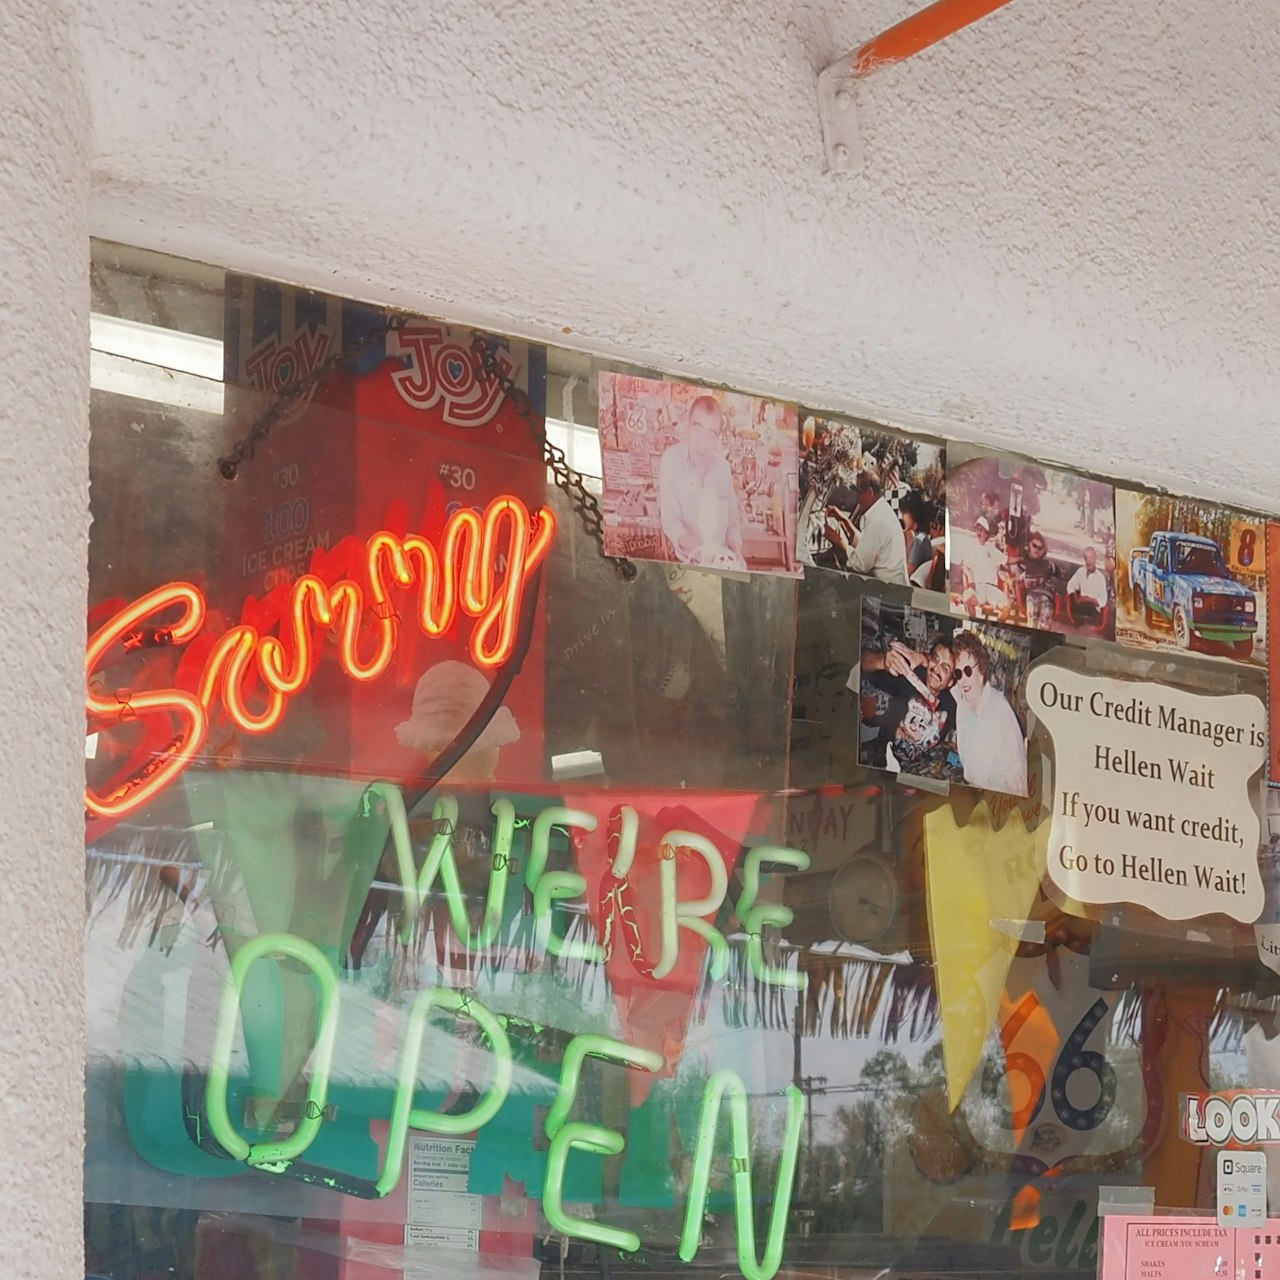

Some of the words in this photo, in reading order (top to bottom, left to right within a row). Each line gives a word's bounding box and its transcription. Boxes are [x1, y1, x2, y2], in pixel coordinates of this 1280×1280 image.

[439, 462, 477, 491] #30
[242, 550, 268, 576] ICE
[271, 531, 331, 566] CREAM
[1238, 528, 1257, 567] 8
[1040, 682, 1084, 713] Our
[1090, 691, 1152, 727] Credit
[1158, 705, 1245, 747] Manager
[1249, 723, 1265, 748] is
[1094, 745, 1162, 780] Hellen
[1168, 758, 1215, 789] Wait
[1062, 791, 1080, 818] If
[1084, 801, 1121, 827] you
[1127, 808, 1176, 834] want
[1181, 817, 1244, 848] credit,
[358, 779, 810, 990] WE'RE
[1059, 845, 1088, 871] Go
[1095, 853, 1115, 876] to
[1121, 854, 1188, 886] Hellen
[1193, 865, 1246, 895] Wait!
[413, 1142, 452, 1153] Nutrition
[413, 1179, 443, 1188] Calories
[1235, 1162, 1262, 1174] Square
[1136, 1229, 1151, 1237] ALL
[1152, 1229, 1179, 1237] PRICES
[1180, 1229, 1213, 1237] INCLUDE
[1214, 1229, 1228, 1237] TAX
[1141, 1270, 1162, 1278] MALTS
